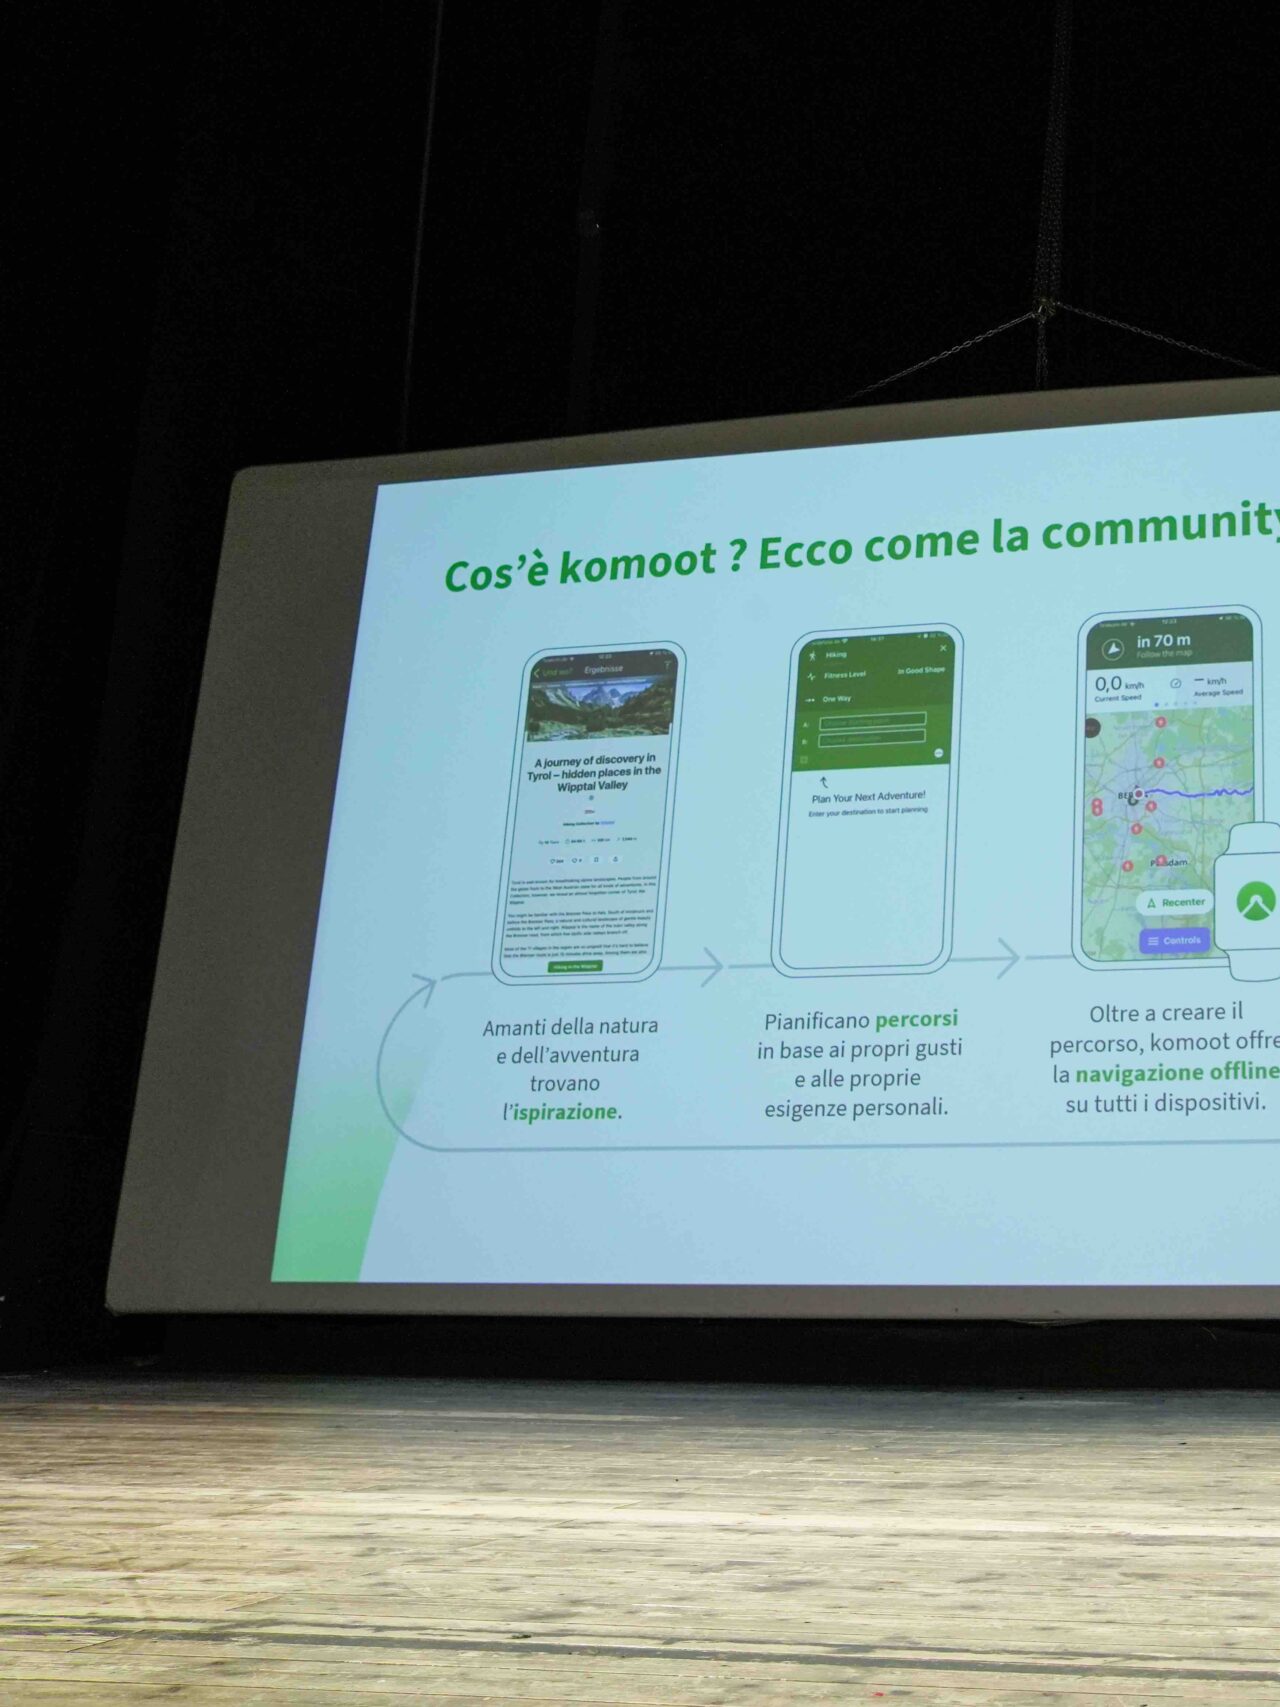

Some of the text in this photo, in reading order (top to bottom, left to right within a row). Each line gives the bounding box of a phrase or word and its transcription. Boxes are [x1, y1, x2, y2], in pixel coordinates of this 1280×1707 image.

[560, 543, 716, 584] komoot
[730, 539, 747, 572] ?
[760, 537, 852, 569] Ecco
[865, 530, 979, 562] come
[993, 518, 1028, 553] la
[1137, 634, 1191, 648] in 70 m
[826, 651, 847, 659] Hiking
[1137, 649, 1192, 659] Follow the map
[584, 664, 624, 675] Ergebnisse
[849, 670, 866, 678] Level
[925, 666, 945, 674] Shape
[1095, 676, 1144, 693] 0,0 km/h
[1207, 677, 1226, 686] km/h
[837, 695, 852, 703] Way
[1094, 695, 1119, 703] Current
[1222, 688, 1244, 696] Speed
[534, 752, 656, 769] A journey of discovery in
[527, 765, 662, 782] Tyrol hidden places in the
[557, 781, 628, 794] Wipptal Valley
[812, 790, 926, 804] Plan Your Next Adventure!
[841, 808, 876, 816] destination
[901, 806, 928, 814] planning
[1163, 898, 1206, 907] Recenter
[1163, 935, 1201, 945] Controls
[1090, 1001, 1243, 1022] Oltre a creare il
[483, 1017, 658, 1036] Amanti della natura
[766, 1009, 957, 1032] Pianificano percorsi
[758, 1038, 962, 1062] in base ai propri gusti
[1051, 1039, 1144, 1058] percorso,
[1151, 1033, 1230, 1051] komoot
[497, 1052, 506, 1064] e
[795, 1068, 920, 1092] e alle proprie
[1054, 1061, 1280, 1087] la navigazione offline
[531, 1076, 599, 1091] trovano
[765, 1096, 947, 1122] esigenze personali.
[1067, 1092, 1265, 1116] su tutti i dispositivi.
